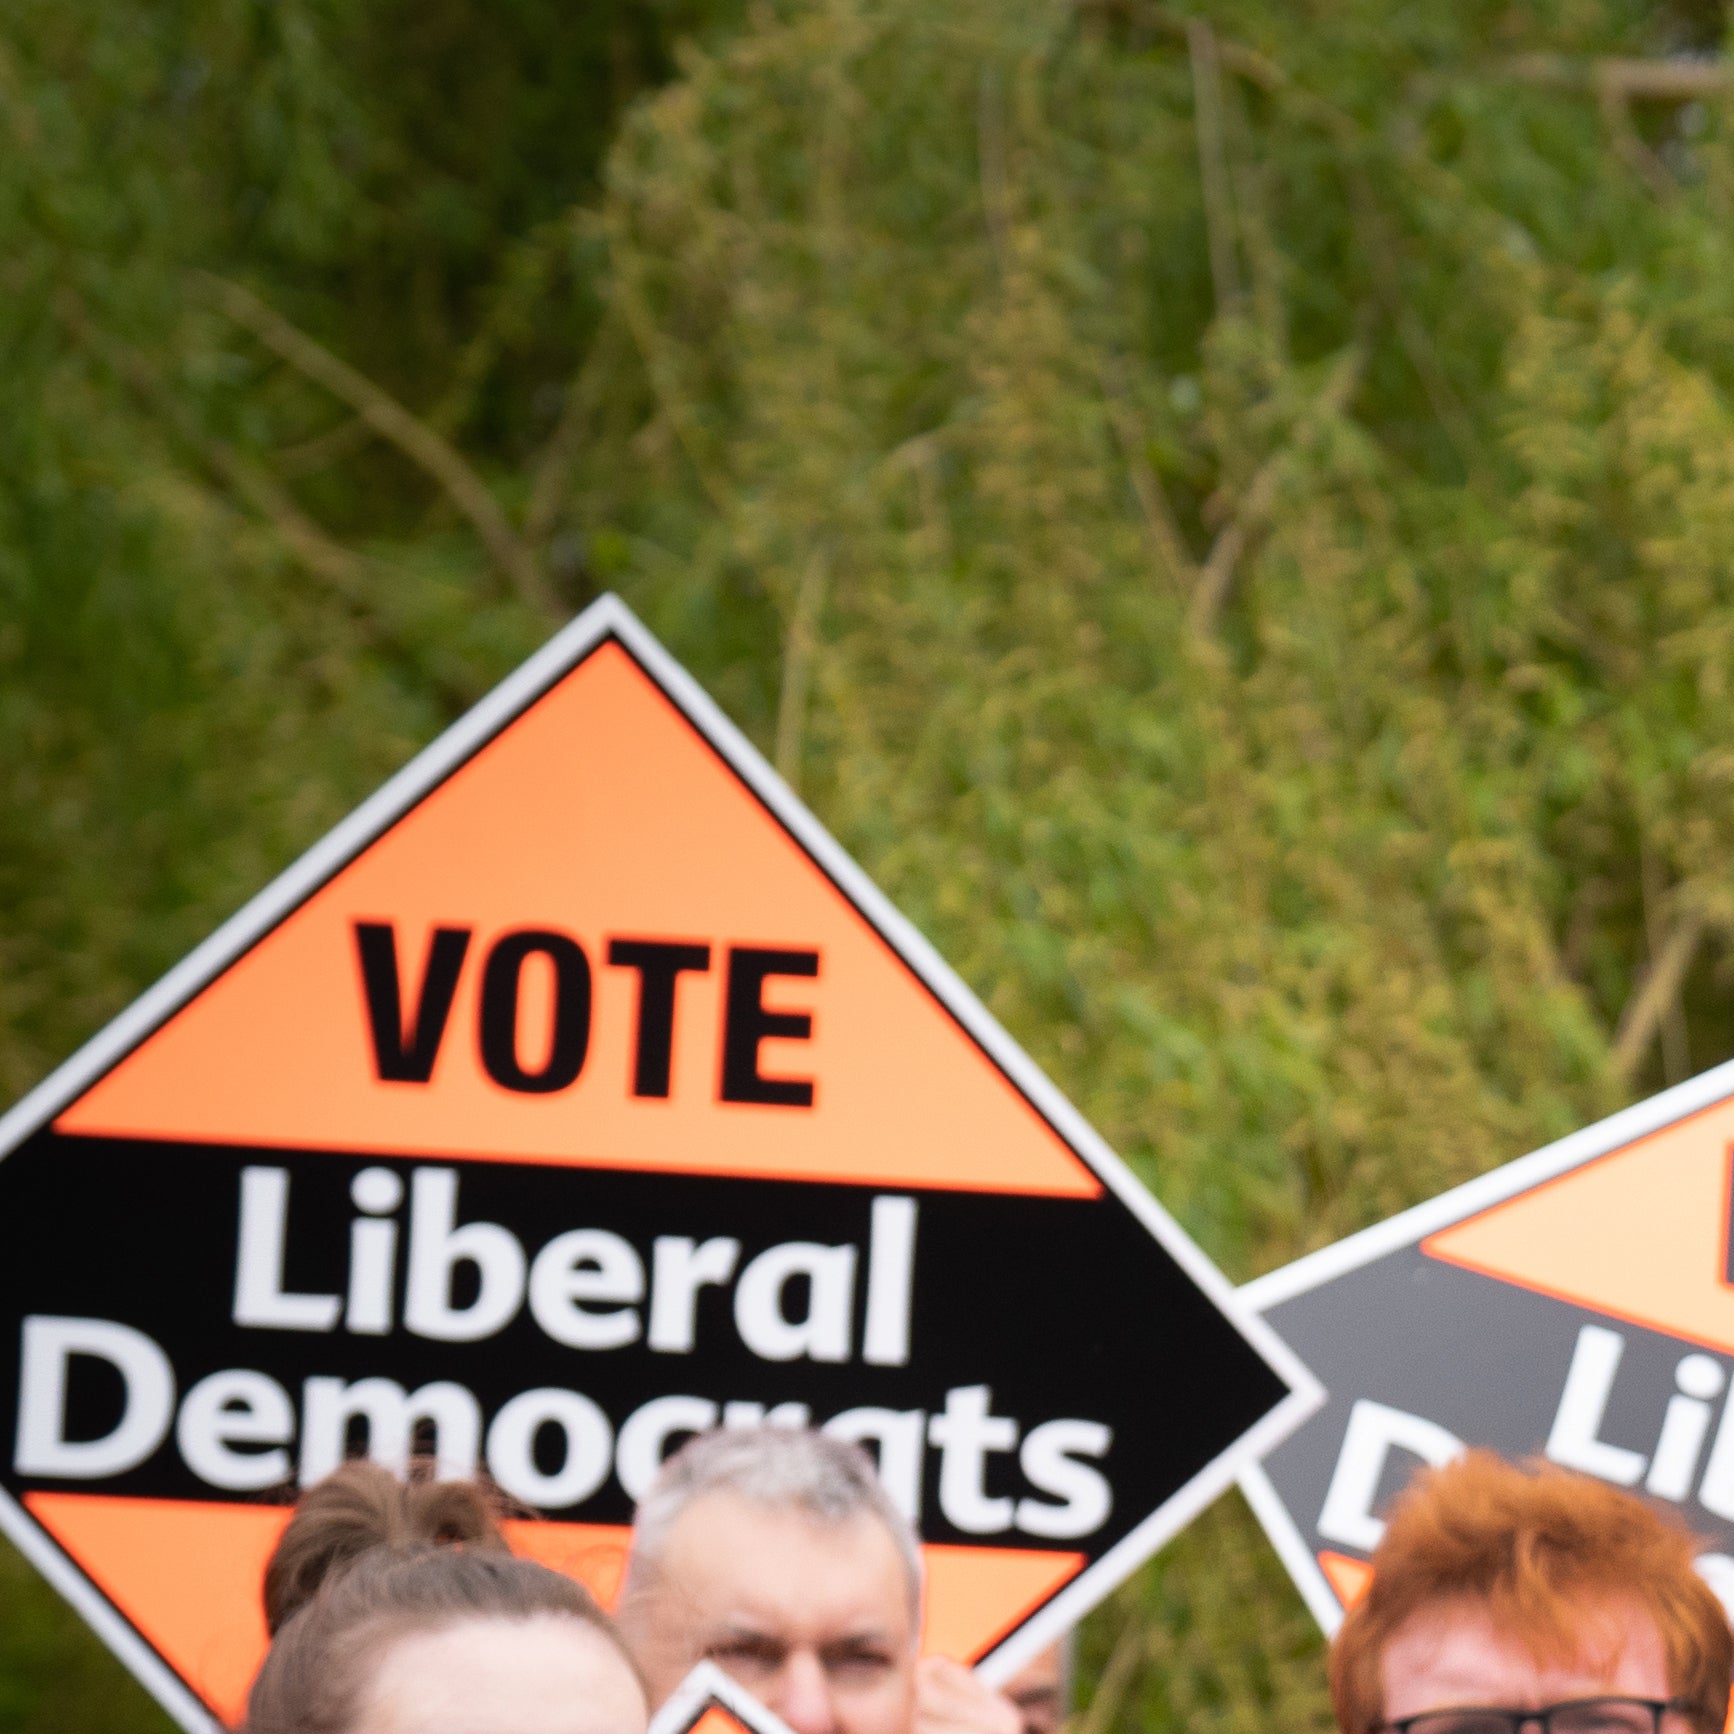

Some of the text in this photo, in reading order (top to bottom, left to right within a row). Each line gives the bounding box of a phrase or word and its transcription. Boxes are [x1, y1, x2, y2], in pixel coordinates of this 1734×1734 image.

[350, 919, 821, 1110] VOTE
[233, 1166, 919, 1367] Liberal
[13, 1312, 1114, 1539] Democats
